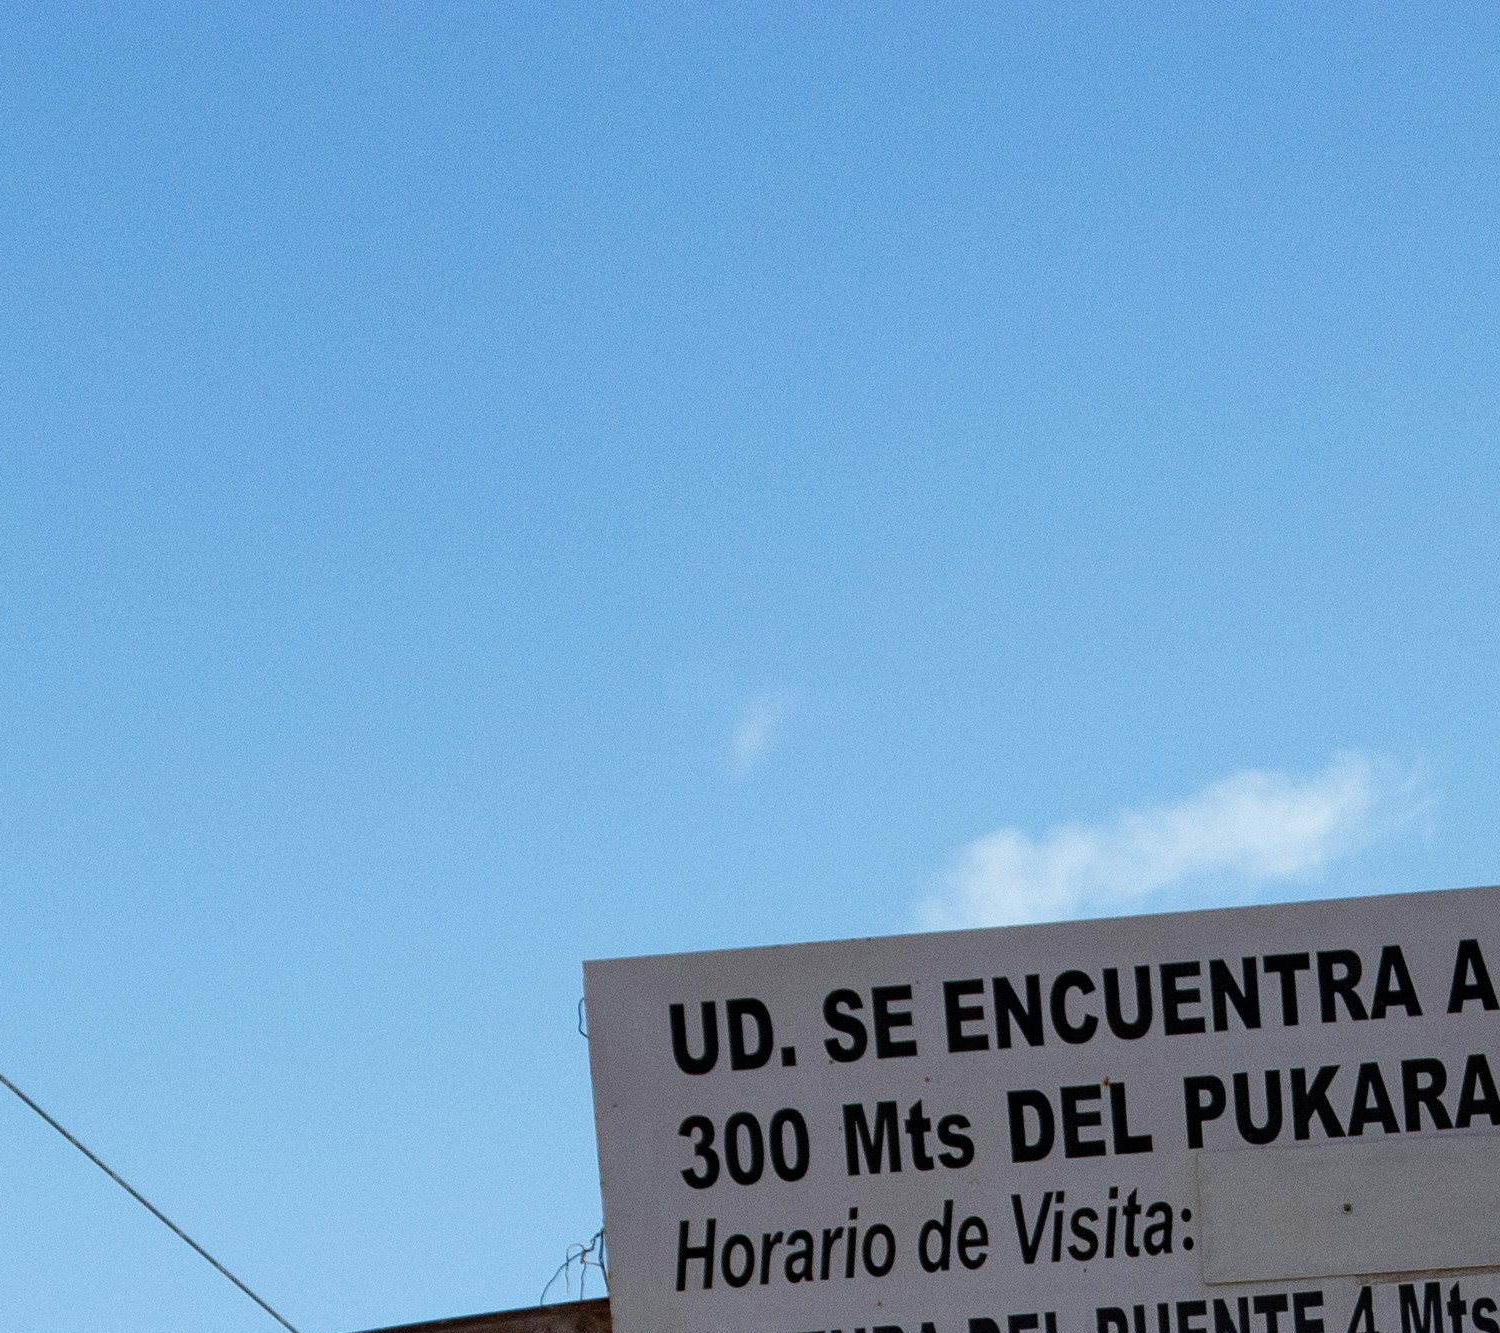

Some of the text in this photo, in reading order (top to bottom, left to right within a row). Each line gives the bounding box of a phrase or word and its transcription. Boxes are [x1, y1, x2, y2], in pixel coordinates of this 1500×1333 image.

[669, 938, 1500, 1076] UD. SE ENCUENTRA A
[678, 1107, 811, 1190] 300
[842, 1099, 975, 1177] Mts
[1006, 1080, 1154, 1163] DEL
[676, 1186, 1195, 1292] Horario de Visita:
